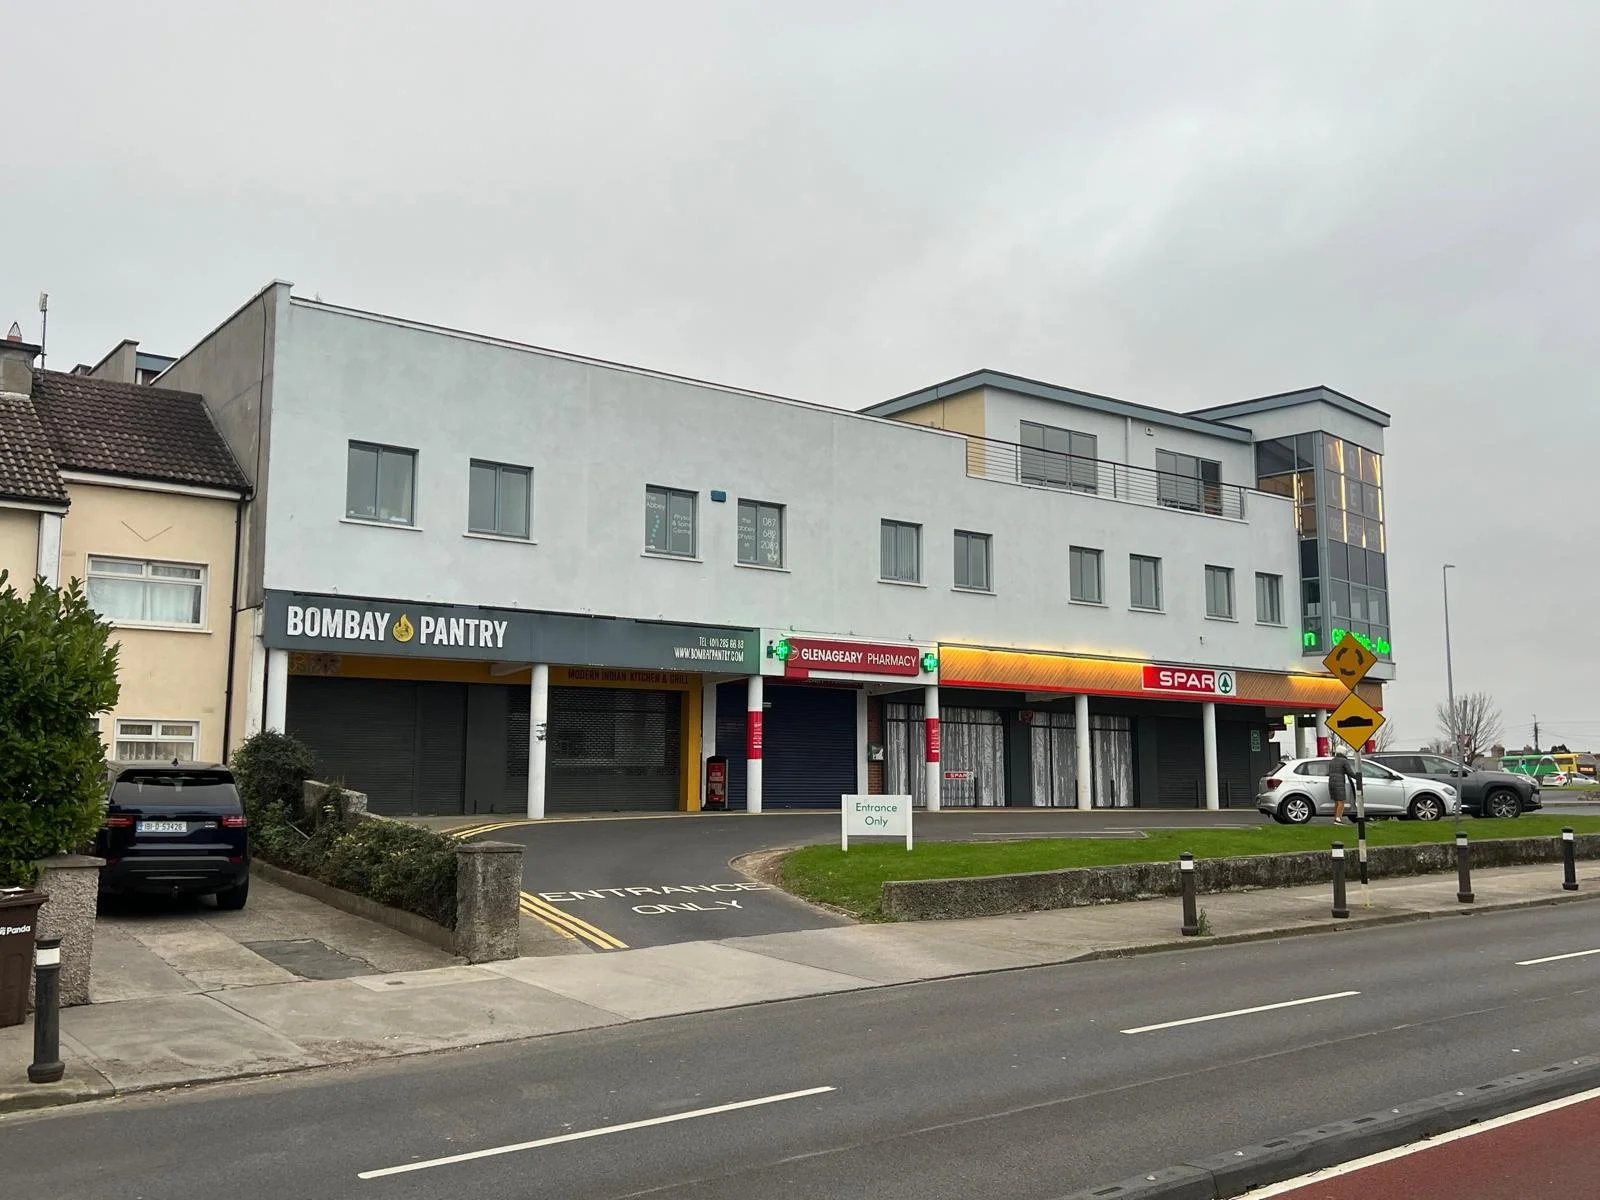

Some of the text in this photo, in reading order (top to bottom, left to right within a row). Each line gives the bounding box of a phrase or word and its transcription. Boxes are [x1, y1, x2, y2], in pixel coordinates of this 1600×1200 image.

[286, 604, 509, 648] BOMBAY PANTRY
[673, 646, 745, 662] WWW.BOMBAYPANTRY.COM
[801, 648, 917, 667] GLENAGEARY PHARMACY
[568, 668, 599, 681] MODERN
[601, 670, 627, 681] INDIAN
[630, 671, 660, 683] KITCHEN
[669, 673, 689, 685] GRILL
[1159, 671, 1215, 689] SPAR
[855, 802, 898, 812] Entrance
[865, 816, 888, 828] Only
[538, 882, 771, 902] ENTRANCE
[631, 899, 744, 915] ONLY
[6, 925, 31, 935] Panda
